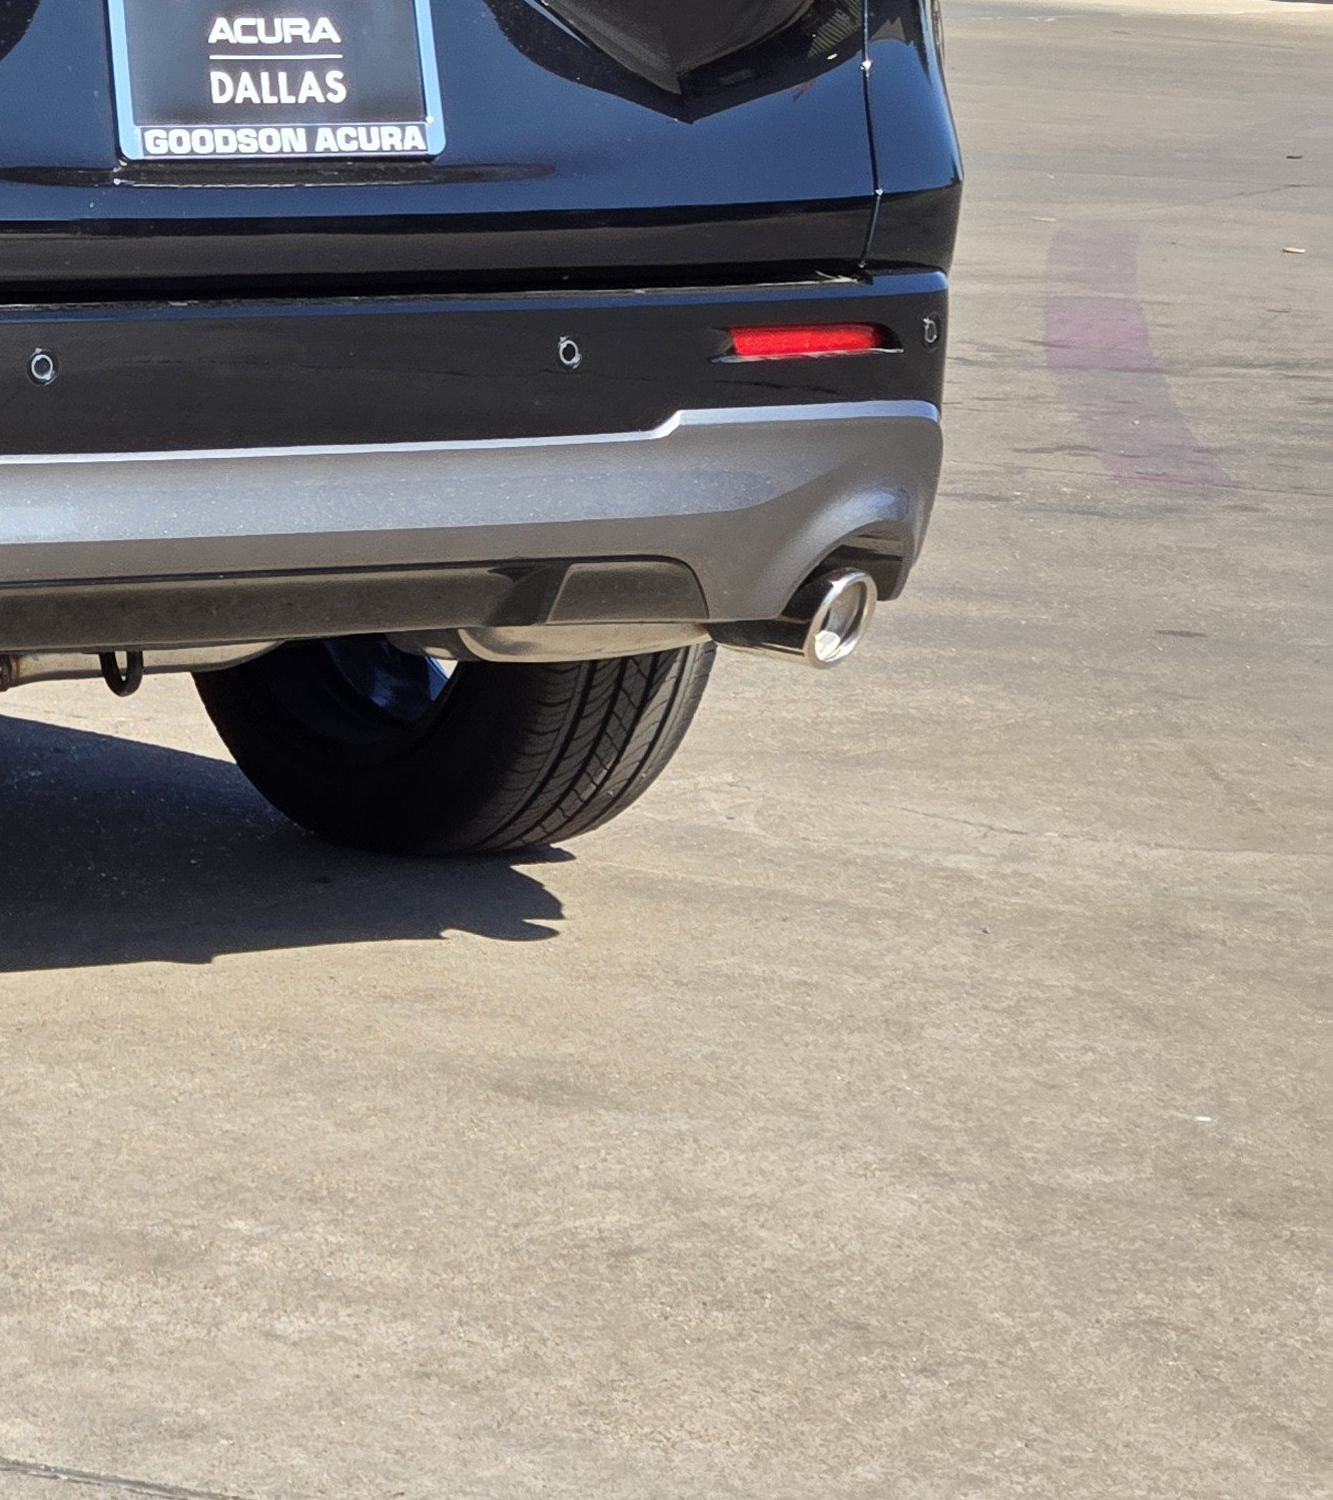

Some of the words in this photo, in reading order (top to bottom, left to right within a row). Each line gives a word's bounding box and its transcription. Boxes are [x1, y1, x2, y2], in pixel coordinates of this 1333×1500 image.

[208, 17, 341, 44] ACURA
[209, 70, 347, 104] DALLAS
[144, 128, 307, 154] GOODSON
[315, 125, 427, 152] ACURA
